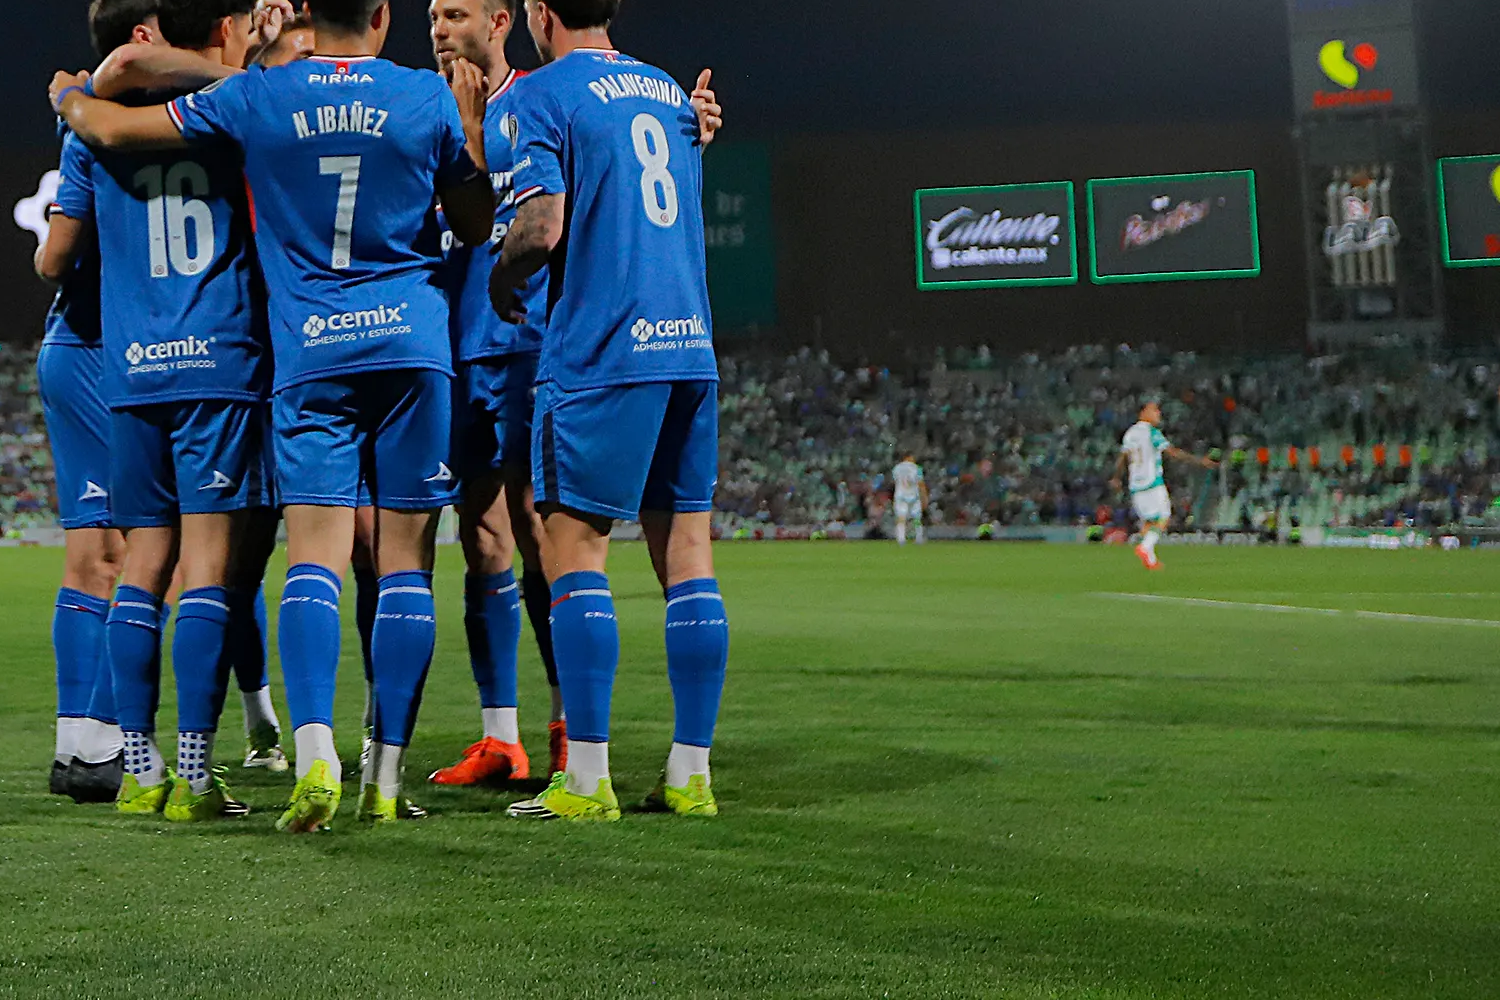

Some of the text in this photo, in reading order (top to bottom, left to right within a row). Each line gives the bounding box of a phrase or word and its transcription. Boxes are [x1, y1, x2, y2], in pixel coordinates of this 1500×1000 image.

[308, 73, 374, 84] PIRMA
[588, 73, 683, 109] PALAVECINO
[292, 100, 389, 139] N. IBAÑEZ
[631, 112, 679, 228] 8
[133, 160, 215, 278] 16
[319, 155, 361, 269] 7
[327, 304, 403, 330] cemix
[144, 335, 209, 359] cemix
[303, 325, 412, 348] ADHESIVOS Y ESTUCOS
[678, 340, 683, 348] Y
[169, 361, 176, 370] Y
[177, 359, 216, 369] ESTUCOS
